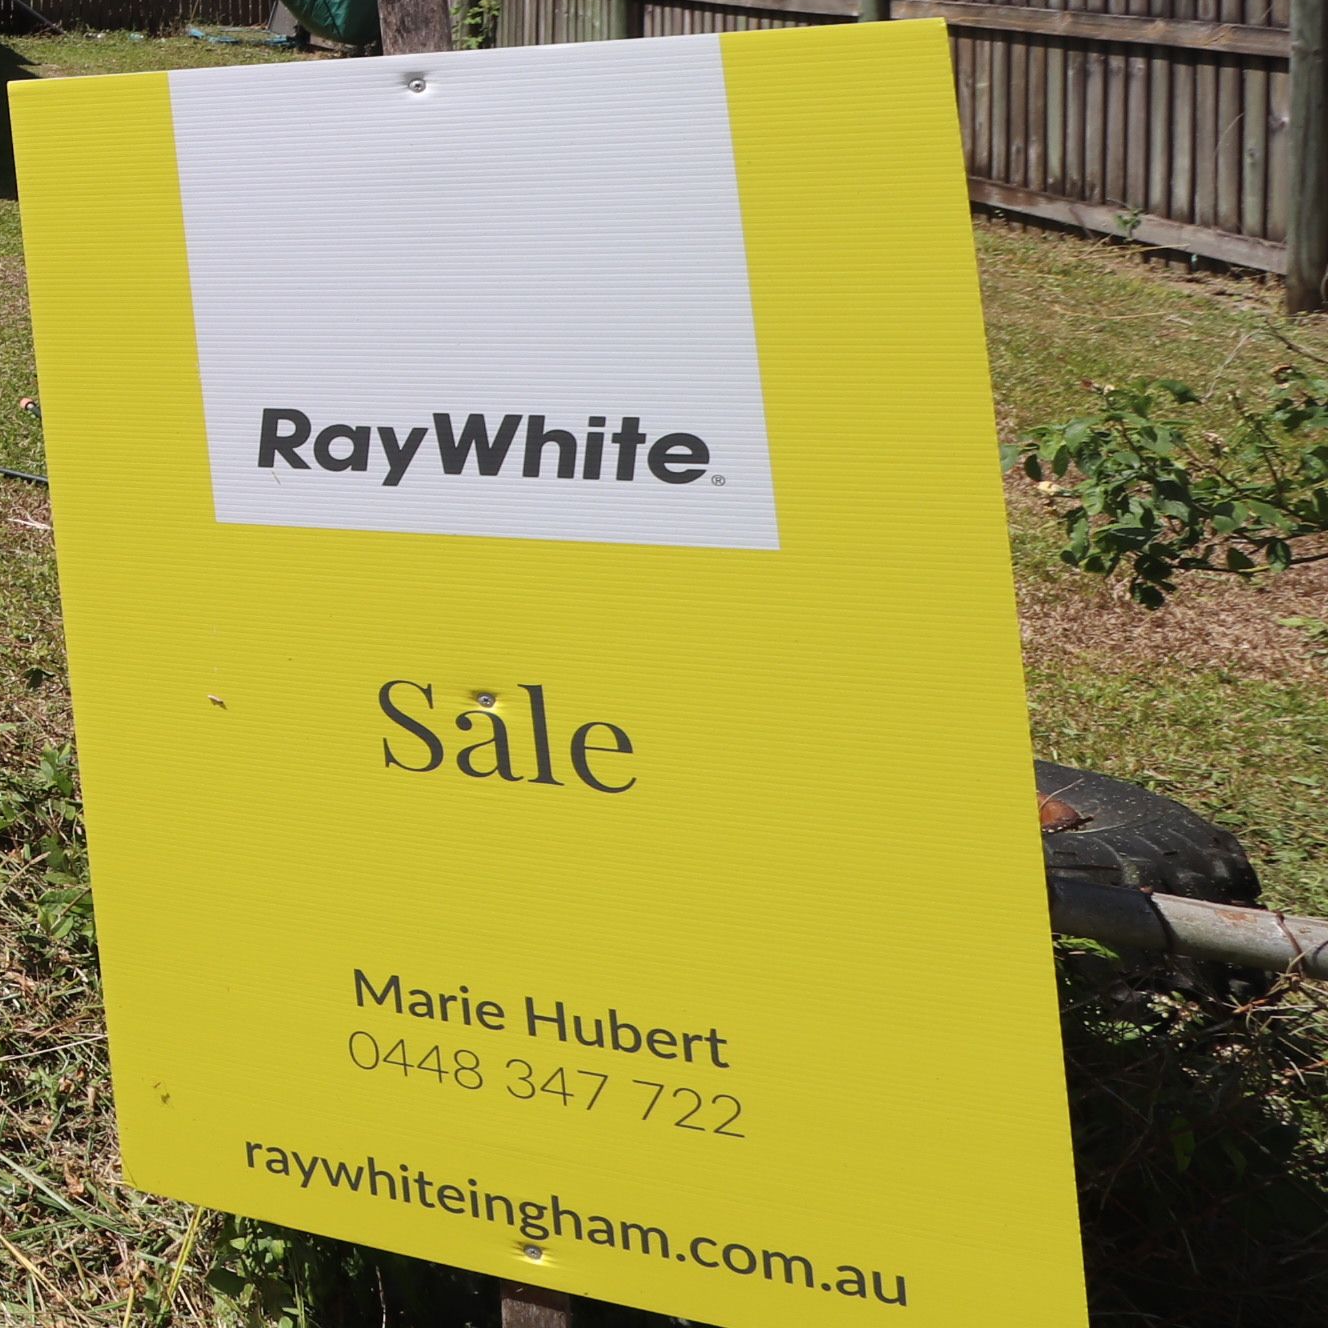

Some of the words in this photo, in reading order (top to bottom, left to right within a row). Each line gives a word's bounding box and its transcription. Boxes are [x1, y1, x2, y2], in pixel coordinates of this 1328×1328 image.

[378, 679, 637, 794] Sale
[353, 968, 505, 1031] Marie
[524, 996, 730, 1069] Hubert
[348, 1030, 484, 1090] 0448
[505, 1058, 609, 1111] 347
[632, 1079, 746, 1138] 722
[245, 1141, 907, 1307] raywhiteingham.com.au
